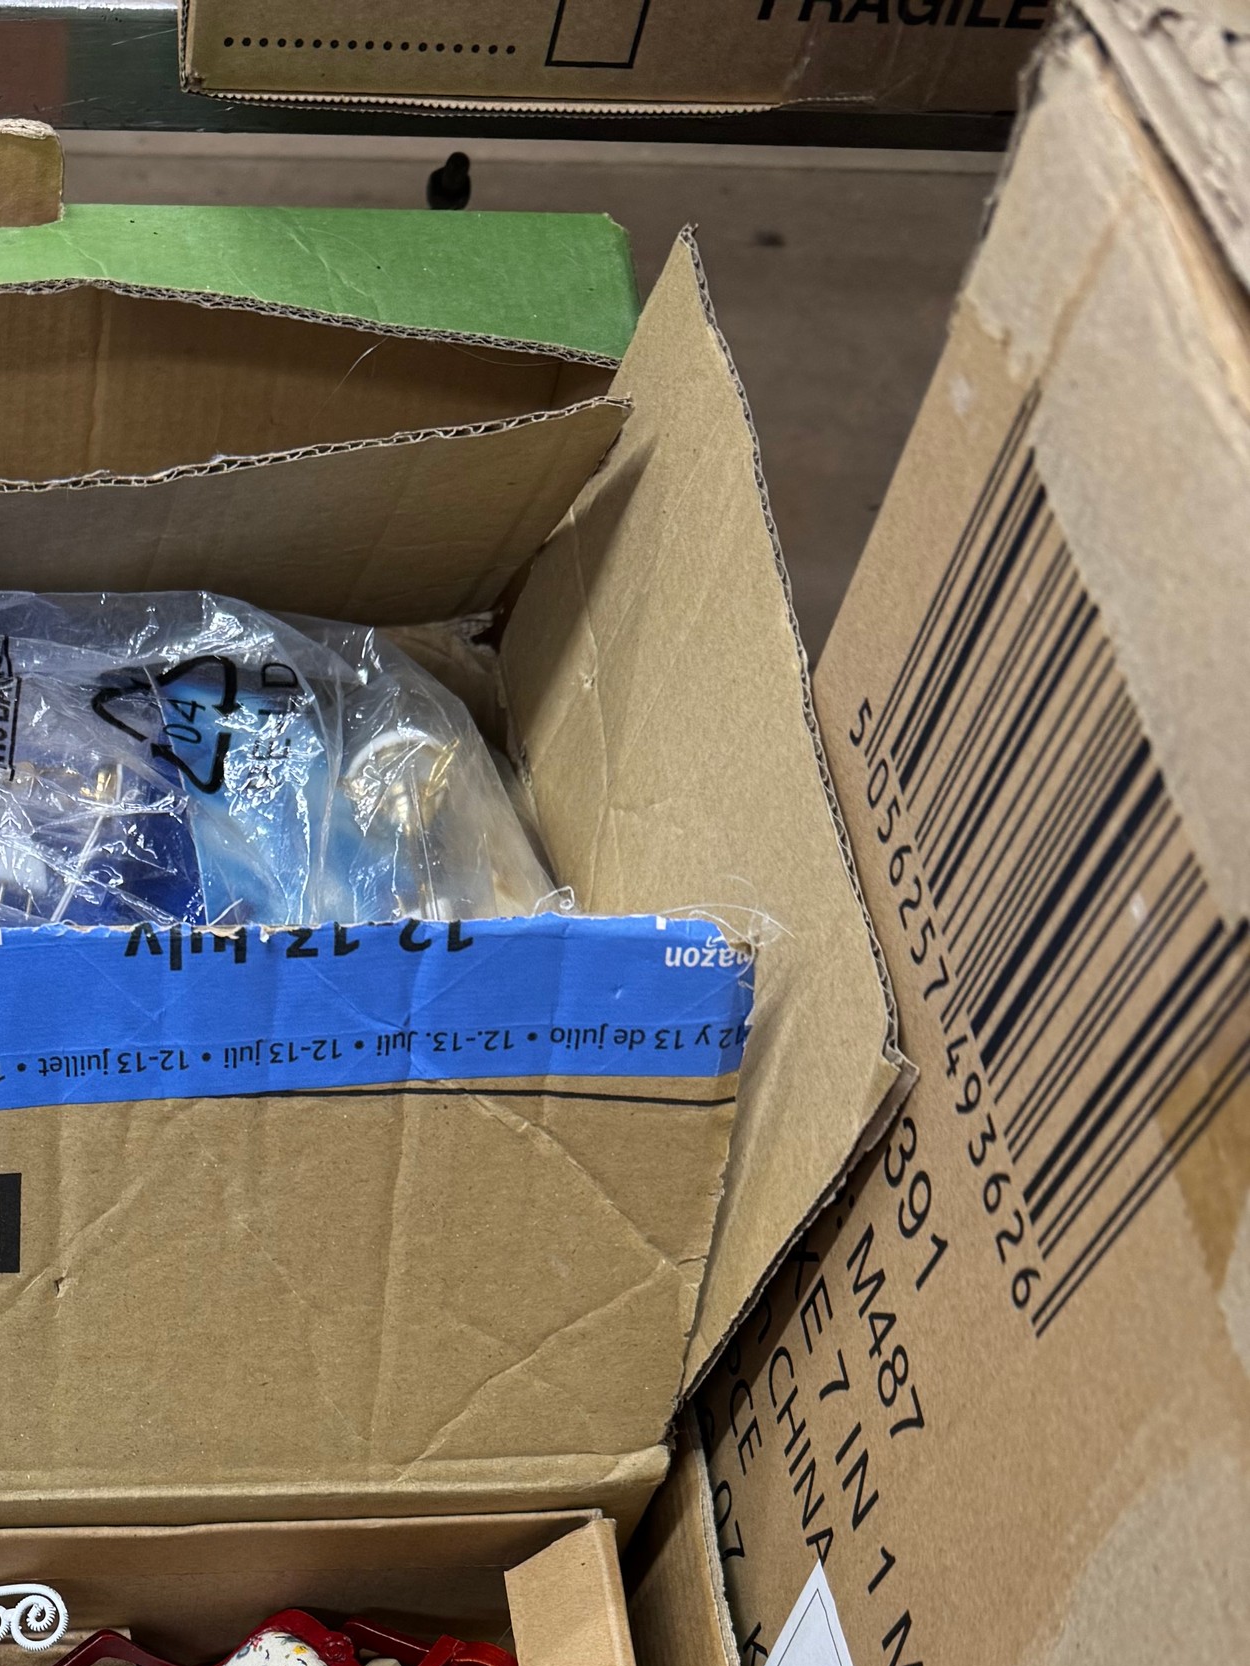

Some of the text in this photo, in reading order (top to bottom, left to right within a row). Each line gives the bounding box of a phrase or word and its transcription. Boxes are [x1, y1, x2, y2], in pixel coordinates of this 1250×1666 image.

[163, 699, 206, 744] 04
[850, 697, 1042, 1310] 5 056257 493626
[377, 1031, 418, 1056] Juli
[426, 1031, 513, 1053] 12.-13.
[551, 1023, 608, 1048] julio
[614, 1028, 646, 1050] de
[655, 1030, 682, 1050] 13
[695, 1025, 711, 1045] y
[39, 1048, 110, 1079] juillet
[118, 1051, 188, 1075] 12-13
[225, 1040, 263, 1069] juli
[269, 1040, 342, 1064] 12-13
[846, 1222, 925, 1439] M487
[768, 1345, 834, 1567] CHINA
[818, 1348, 850, 1402] 7
[835, 1421, 880, 1531] IN
[867, 1546, 897, 1595] 1
